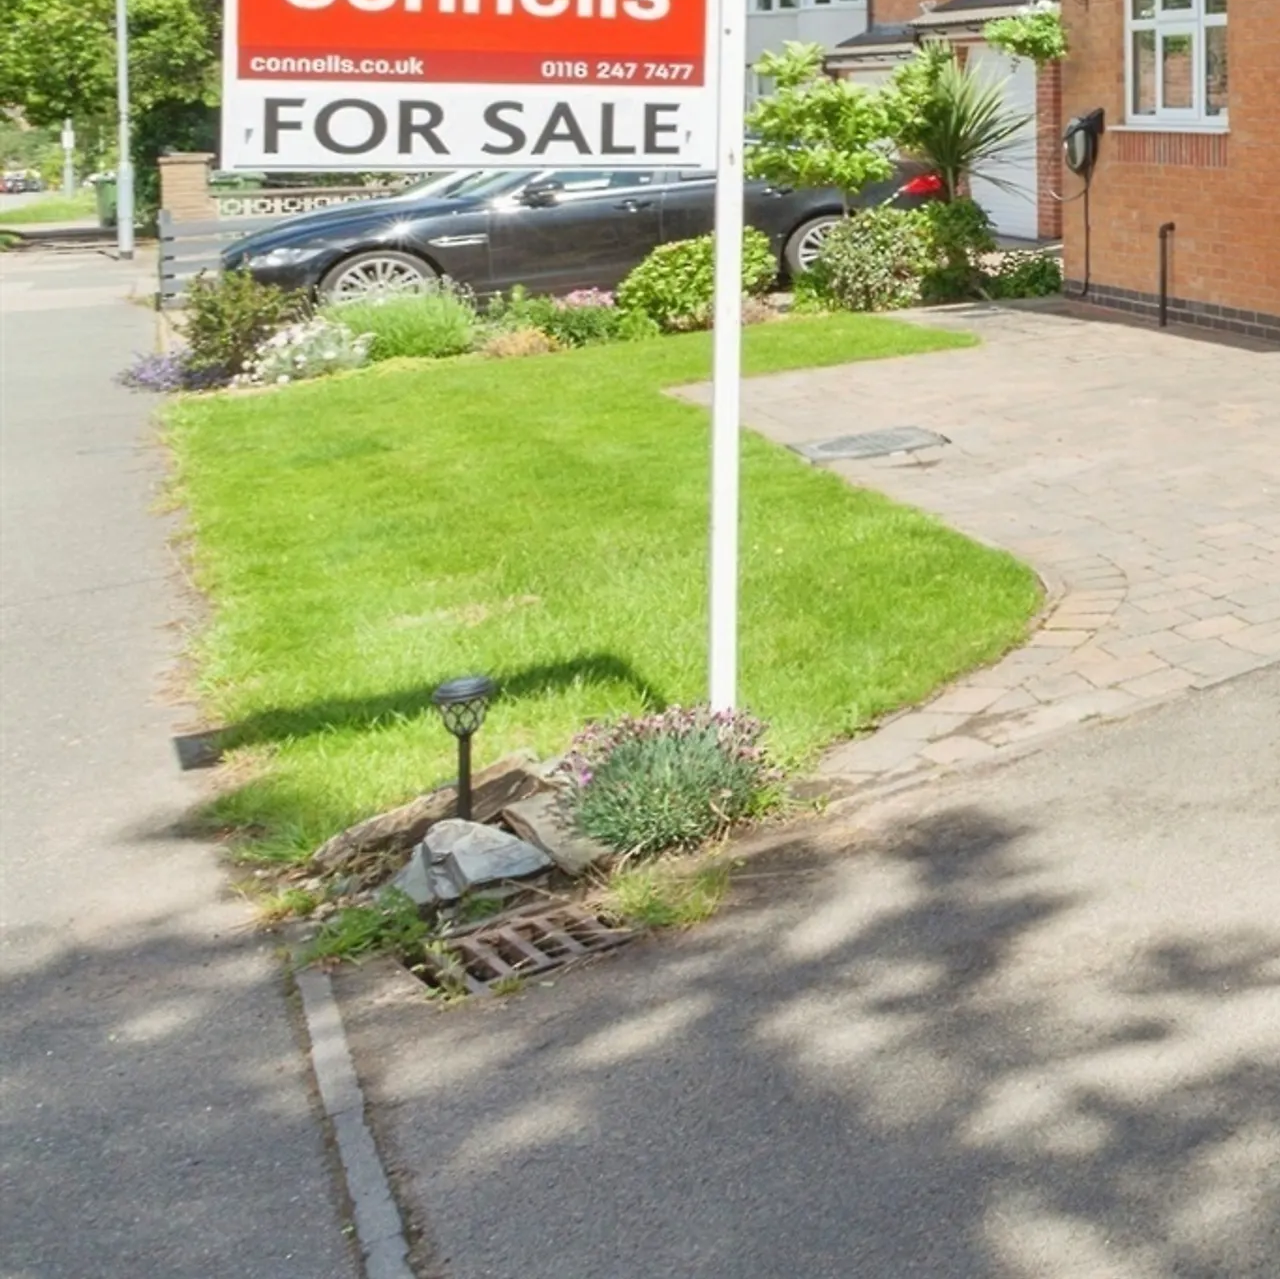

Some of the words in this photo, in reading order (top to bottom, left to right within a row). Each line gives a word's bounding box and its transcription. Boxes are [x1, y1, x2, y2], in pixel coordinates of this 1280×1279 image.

[250, 54, 424, 75] connells.co.uk
[541, 60, 588, 79] 0116
[596, 61, 638, 80] 247
[643, 62, 694, 80] 7477
[263, 97, 450, 155] FOR
[481, 101, 680, 155] SALE
